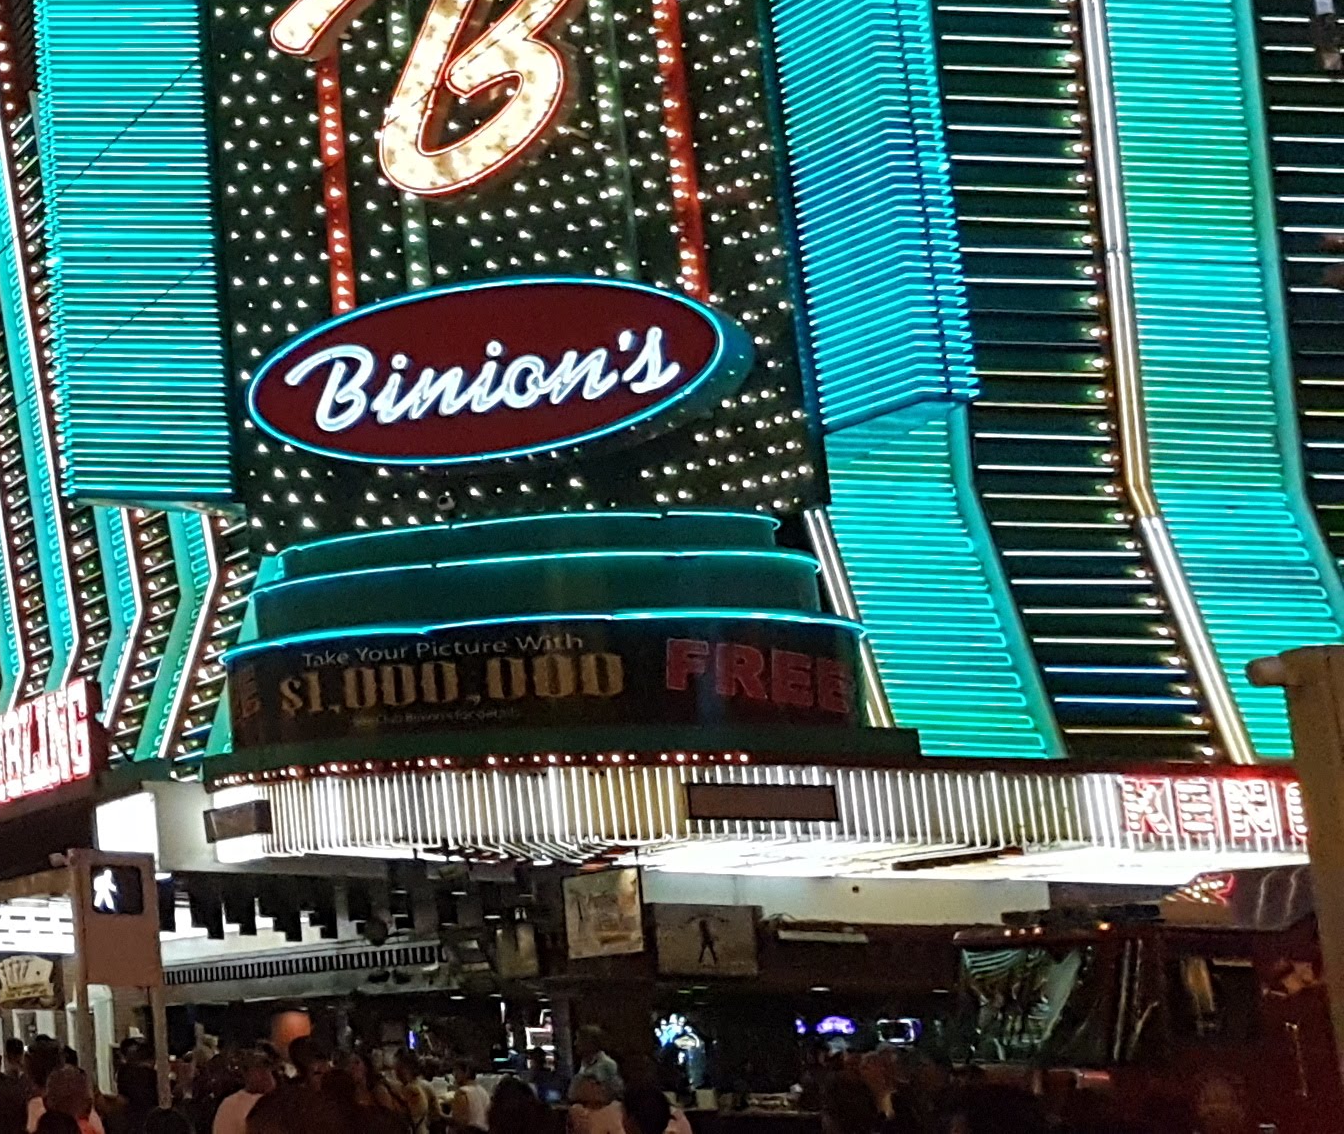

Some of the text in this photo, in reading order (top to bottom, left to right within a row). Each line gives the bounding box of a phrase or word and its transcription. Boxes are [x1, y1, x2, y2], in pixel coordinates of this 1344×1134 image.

[284, 326, 682, 432] Binion's
[278, 652, 625, 717] $1,000,000
[302, 633, 584, 667] Take Your Picture With
[666, 637, 850, 714] FREE
